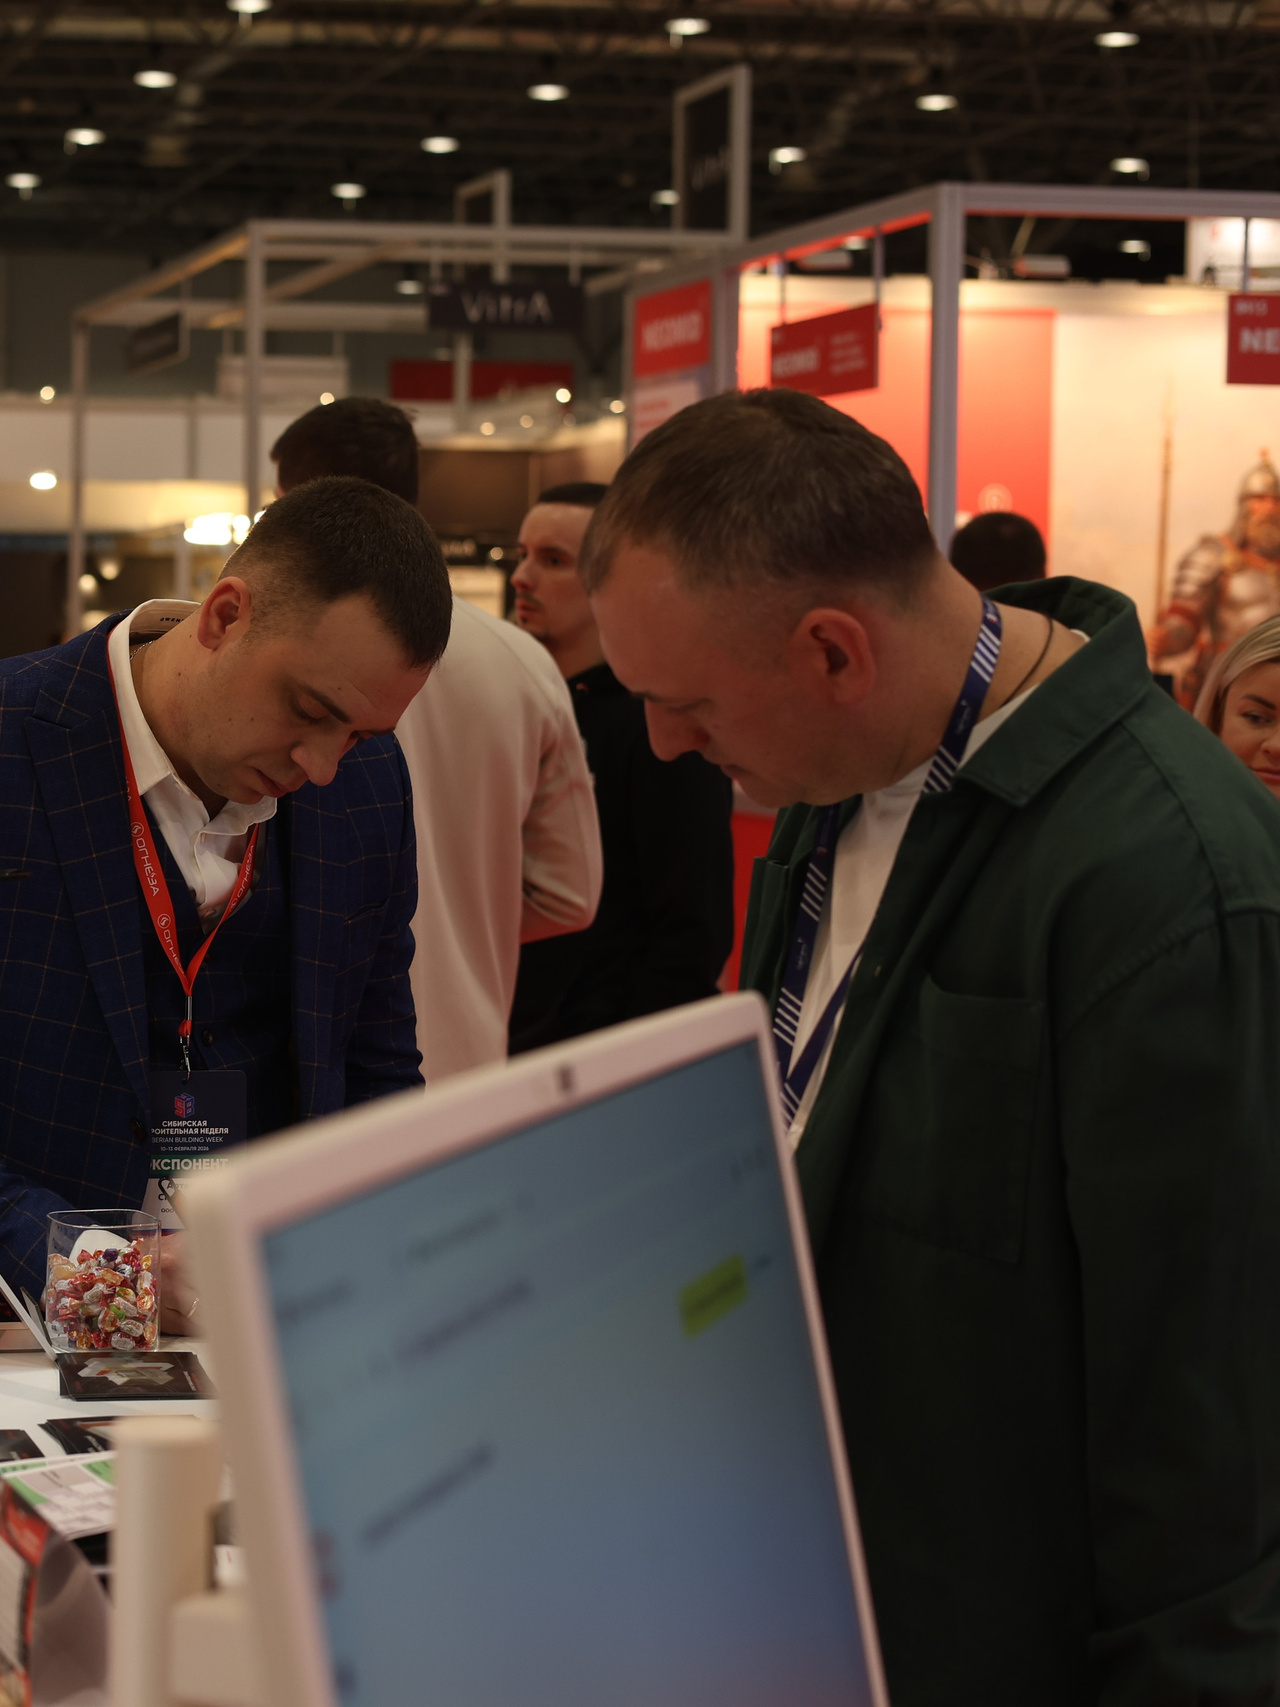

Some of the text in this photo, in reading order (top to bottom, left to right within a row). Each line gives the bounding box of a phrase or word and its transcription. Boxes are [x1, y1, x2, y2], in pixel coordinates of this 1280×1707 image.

[1239, 325, 1280, 356] NE
[135, 837, 160, 897] ОГНЕЗА
[163, 929, 189, 986] ОГНЕ
[161, 1120, 208, 1128] СИБИРСКАЯ
[200, 1127, 229, 1135] НЕДЕЛЯ
[150, 1158, 229, 1171] КСПОНЕНТ
